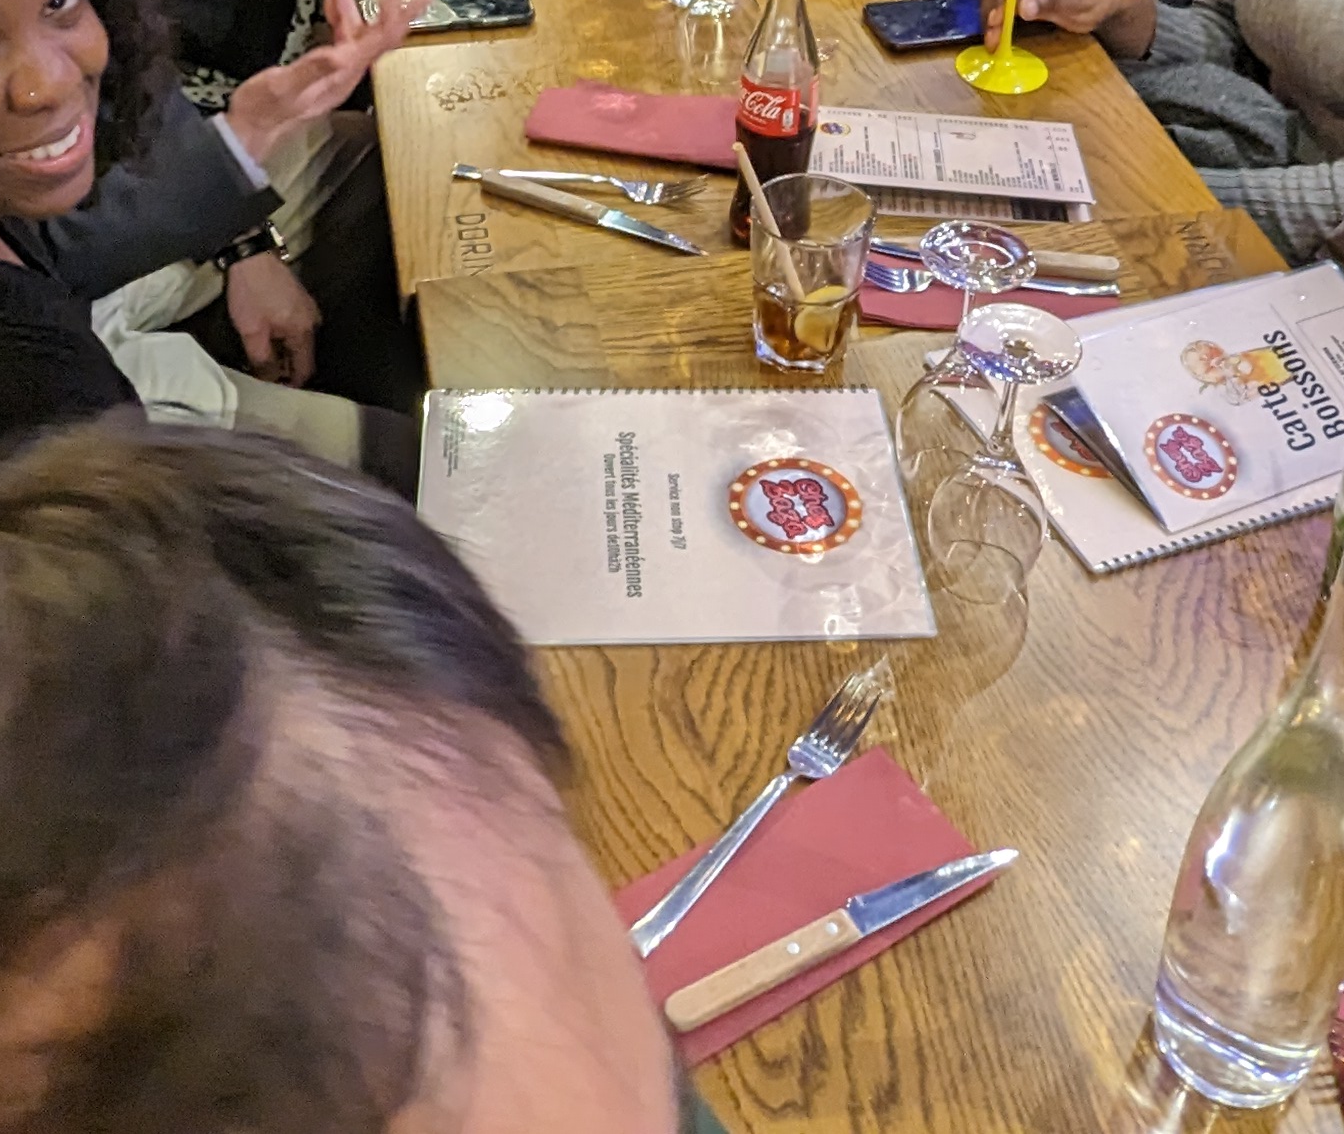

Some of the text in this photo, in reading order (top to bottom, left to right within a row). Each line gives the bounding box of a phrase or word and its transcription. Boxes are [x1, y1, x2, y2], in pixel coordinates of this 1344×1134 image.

[1257, 381, 1316, 452] Carte
[603, 453, 616, 479] Ouvert
[605, 480, 617, 497] tous
[667, 473, 682, 501] Service
[605, 499, 618, 511] les
[615, 431, 646, 598] Spécialités Méditerranéennes
[603, 511, 620, 533] jours
[670, 517, 683, 535] stop
